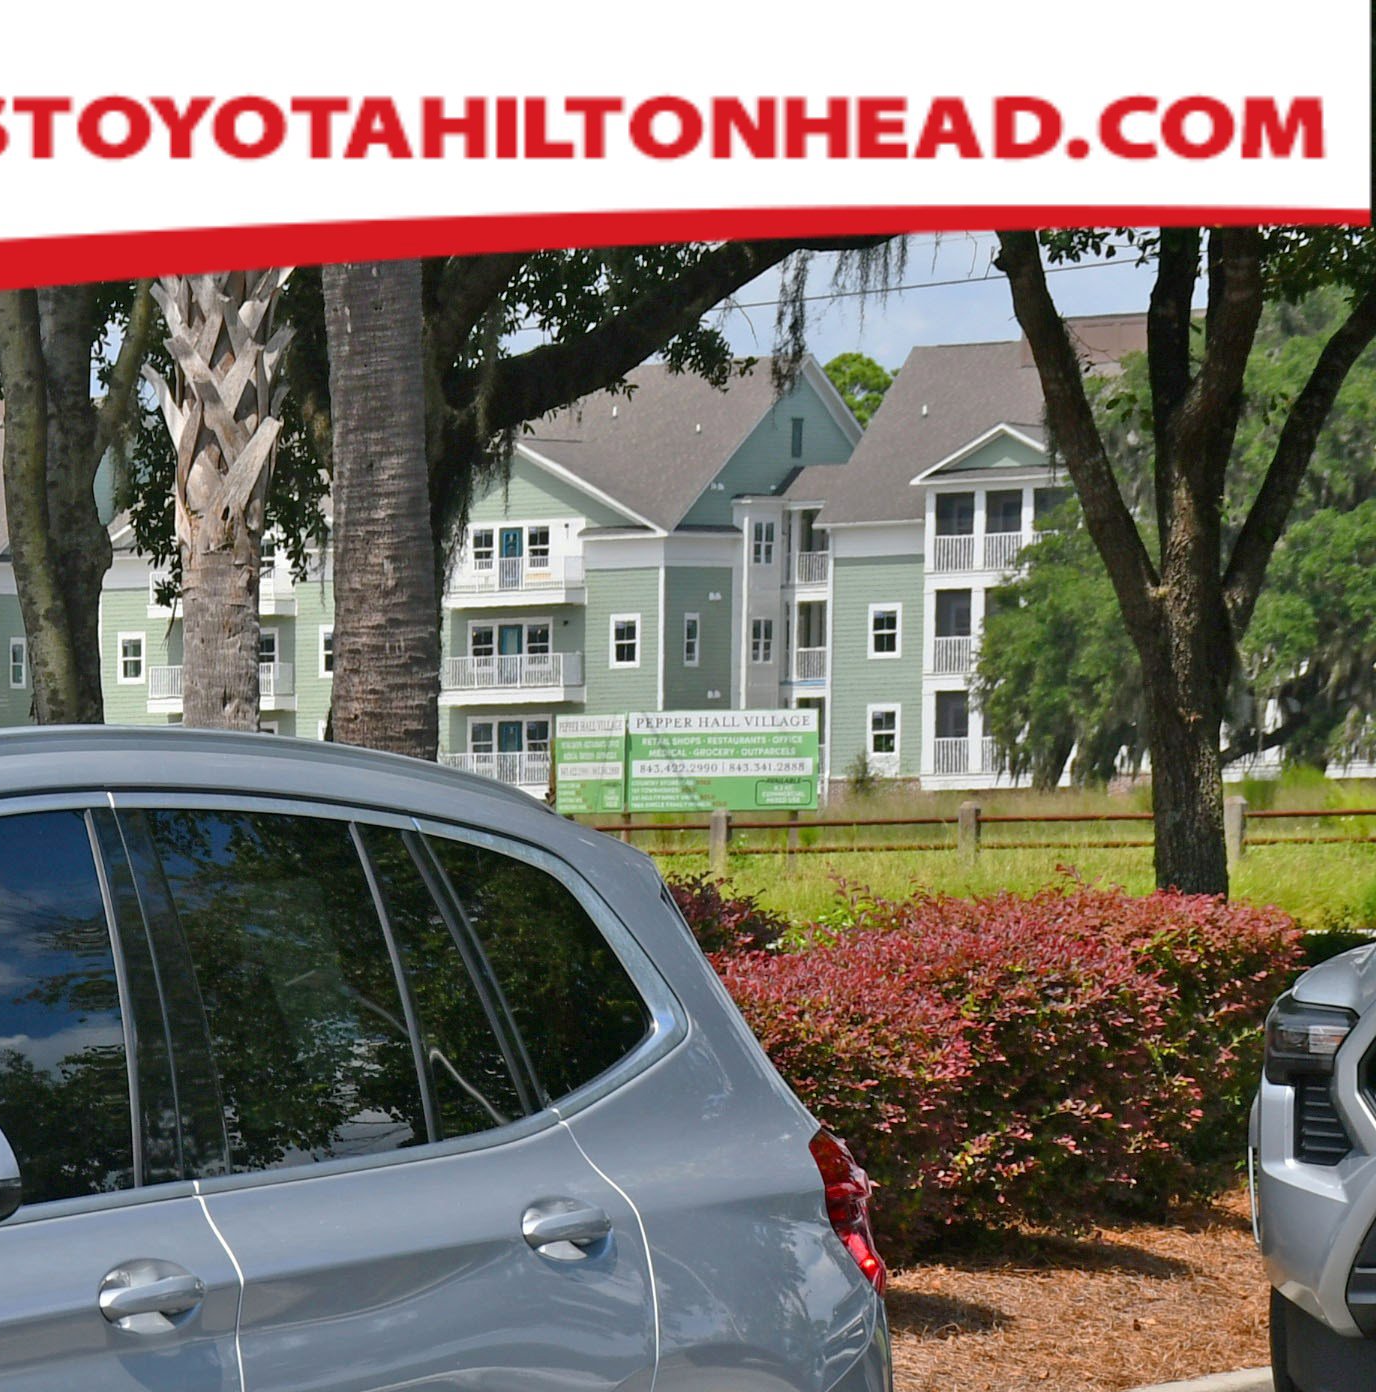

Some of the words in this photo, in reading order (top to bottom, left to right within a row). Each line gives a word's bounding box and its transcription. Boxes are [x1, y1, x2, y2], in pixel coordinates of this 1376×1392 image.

[636, 717, 693, 729] PEPPER
[698, 716, 740, 728] HALL
[744, 714, 810, 727] VILLAGE
[672, 736, 701, 746] SHOPS
[707, 735, 766, 745] RESTAURANTS
[772, 735, 803, 744] OFFICE
[693, 748, 735, 757] GROCERY
[740, 747, 796, 756] OUTPARCELS
